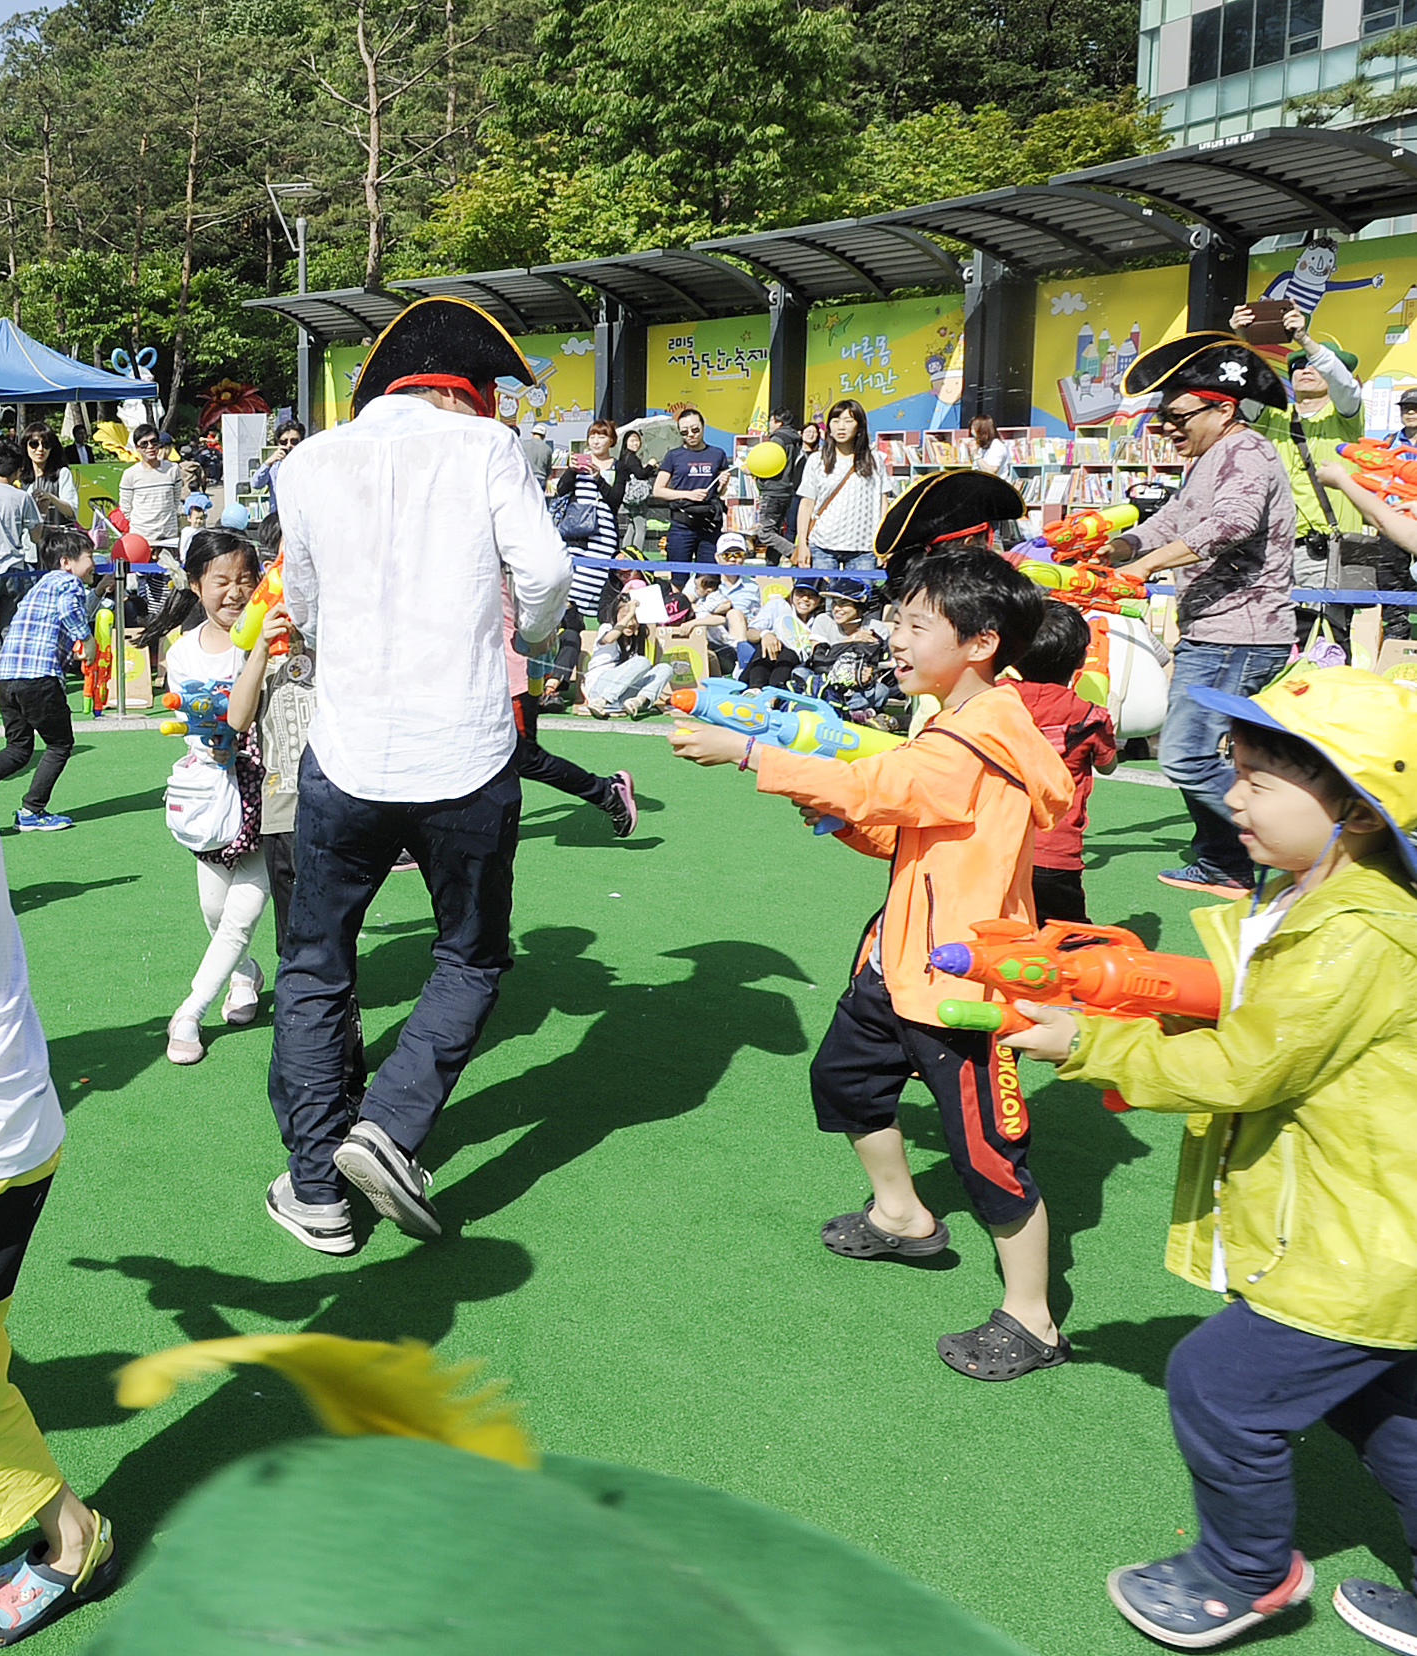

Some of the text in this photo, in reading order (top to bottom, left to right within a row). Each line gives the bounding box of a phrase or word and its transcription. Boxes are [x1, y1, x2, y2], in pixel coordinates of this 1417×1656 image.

[668, 337, 693, 350] 2015
[841, 335, 892, 367] 나루몽
[840, 367, 899, 394] 도서관
[997, 1060, 1021, 1135] KOLON
